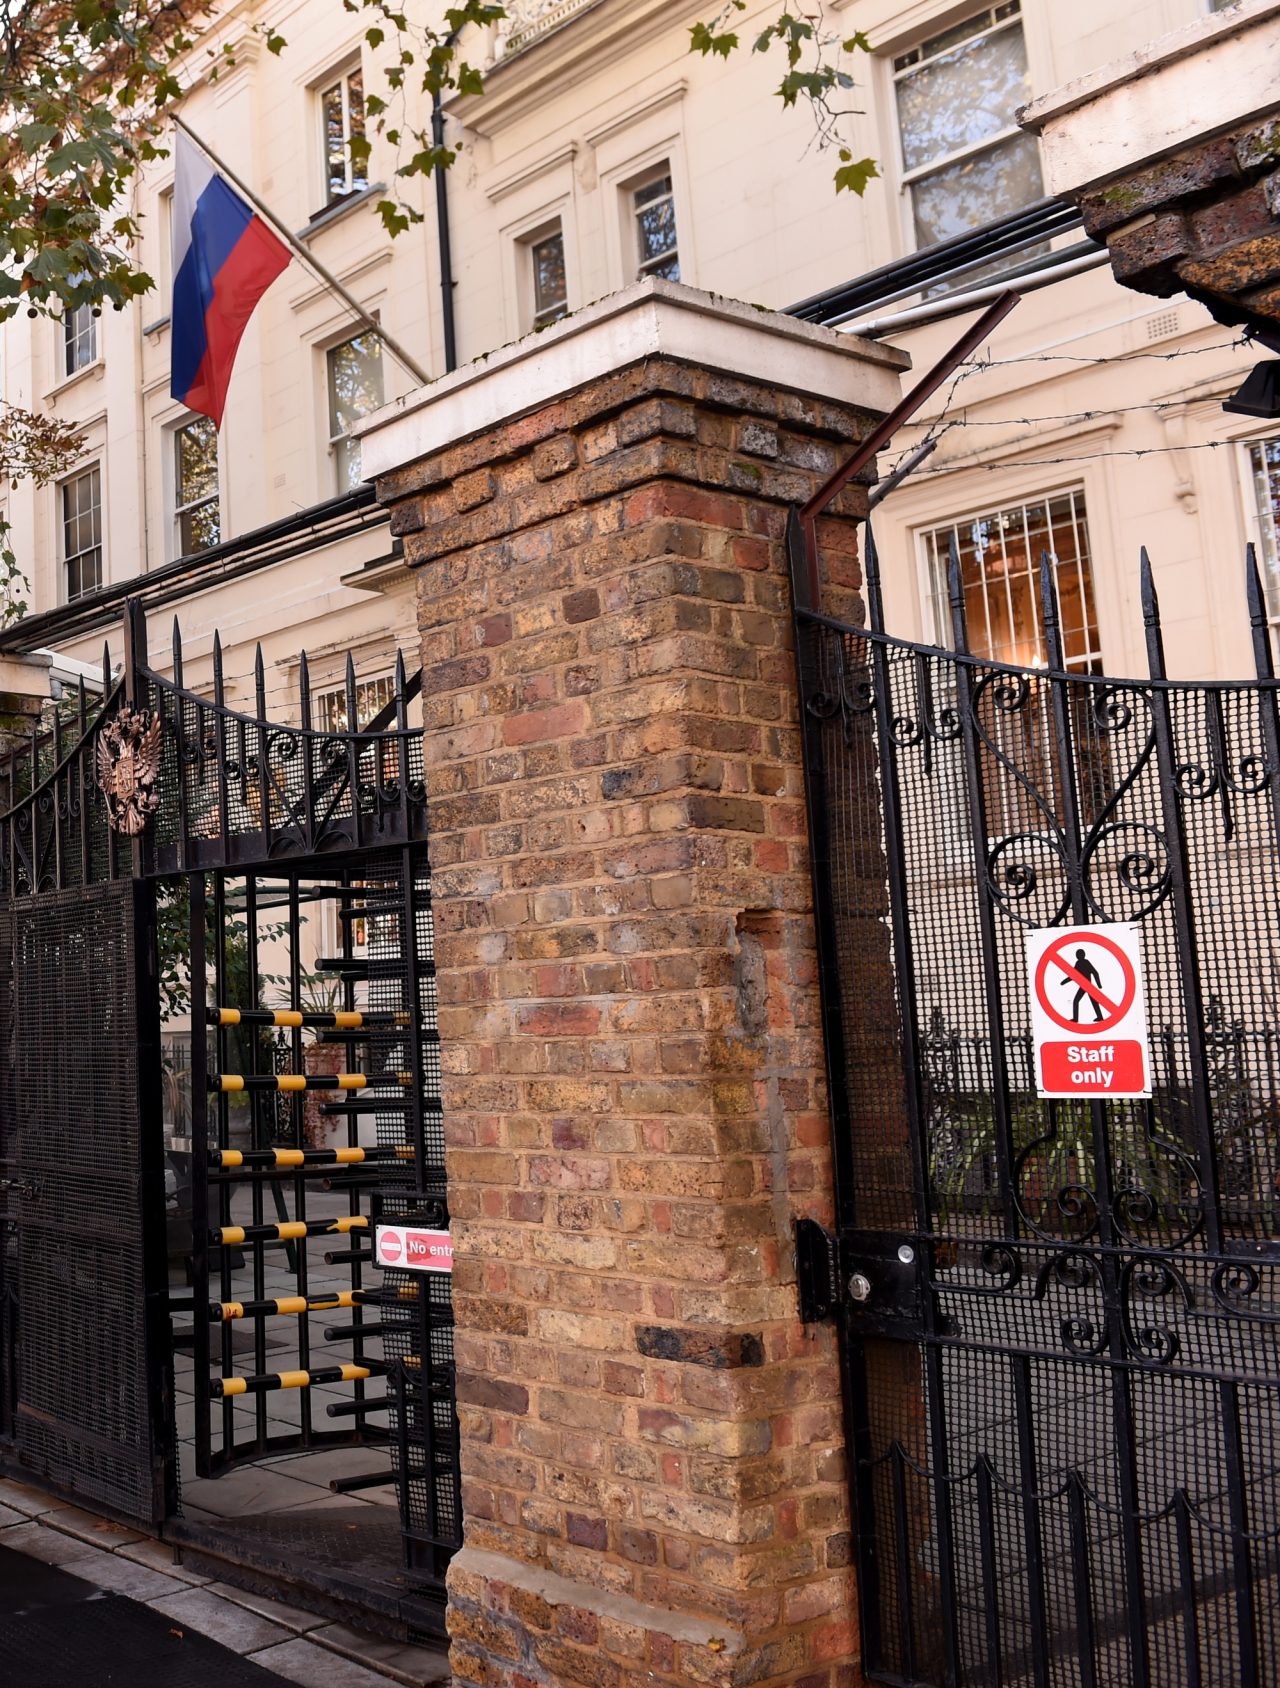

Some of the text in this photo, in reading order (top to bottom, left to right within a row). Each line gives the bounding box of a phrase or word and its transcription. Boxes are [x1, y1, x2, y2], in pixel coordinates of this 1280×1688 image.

[1067, 1046, 1114, 1063] Staff
[1071, 1067, 1114, 1087] only
[409, 1241, 454, 1257] No entr
